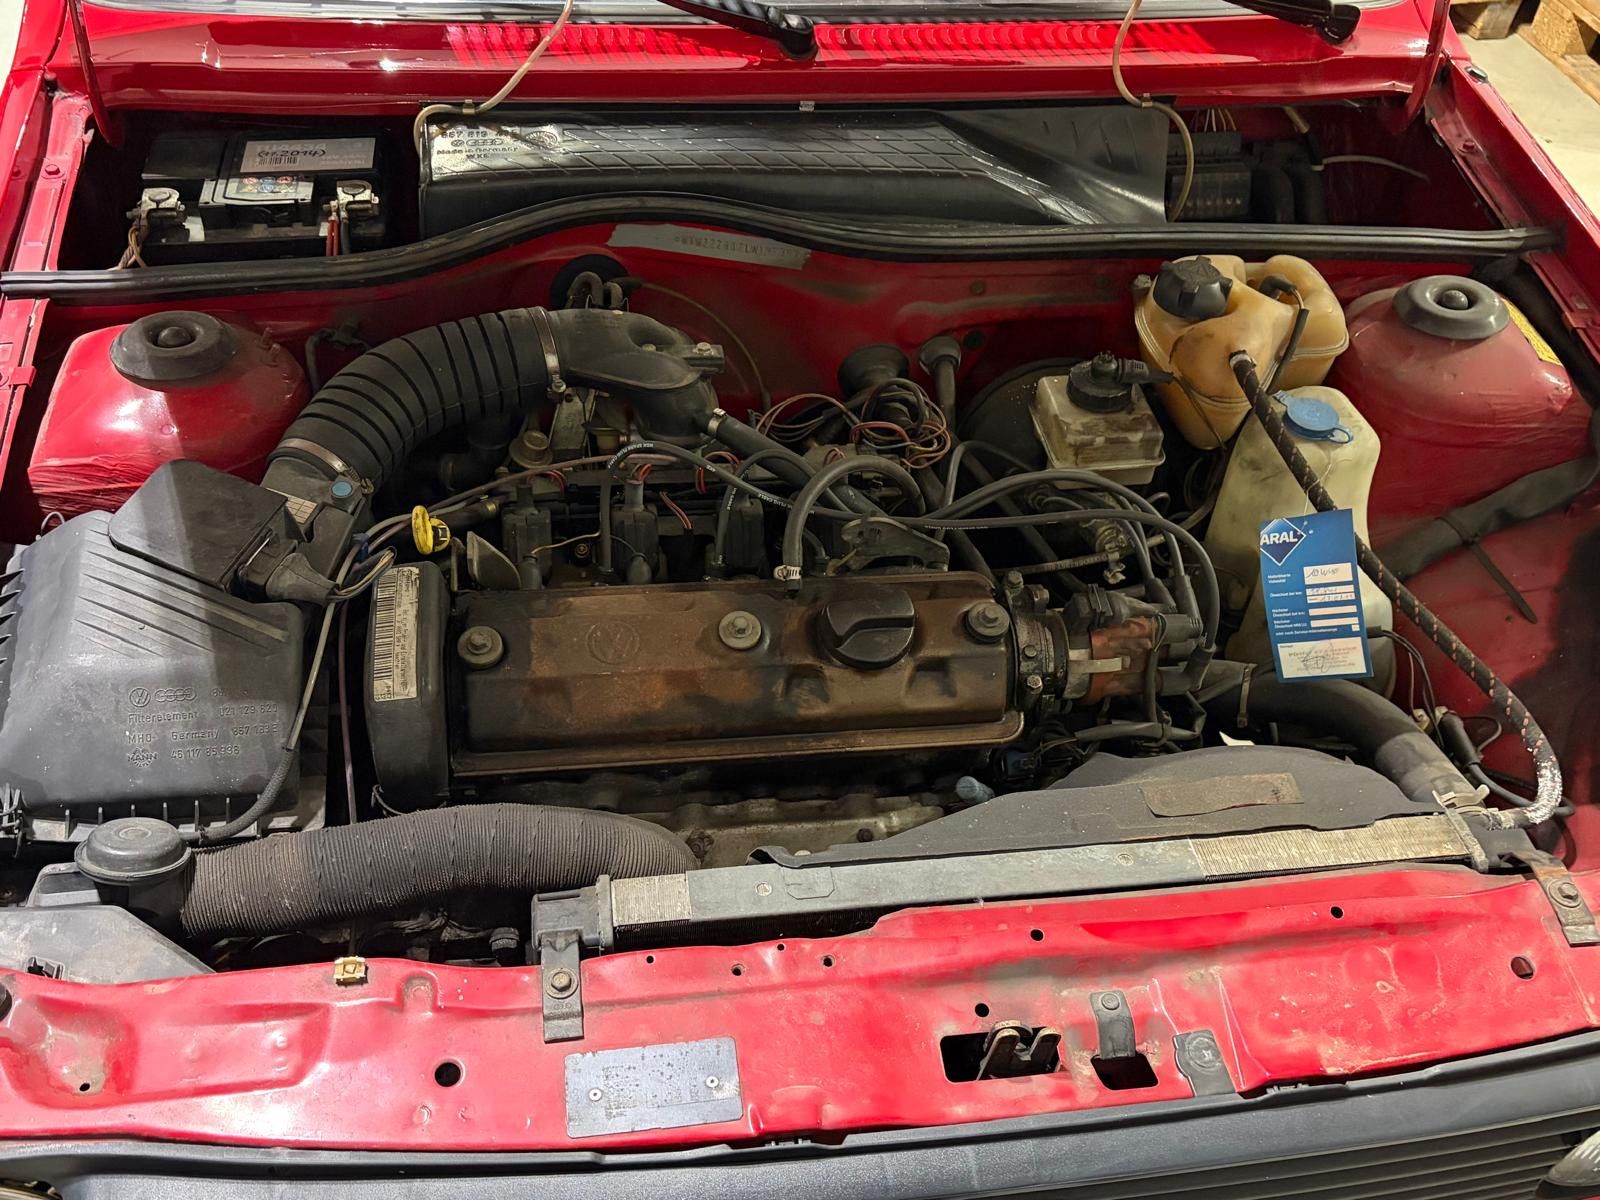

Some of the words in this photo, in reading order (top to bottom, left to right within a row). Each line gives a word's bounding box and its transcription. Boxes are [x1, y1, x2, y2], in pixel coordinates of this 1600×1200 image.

[1260, 532, 1299, 546] ARAL
[128, 711, 199, 724] Filterelement
[171, 728, 220, 741] Germany
